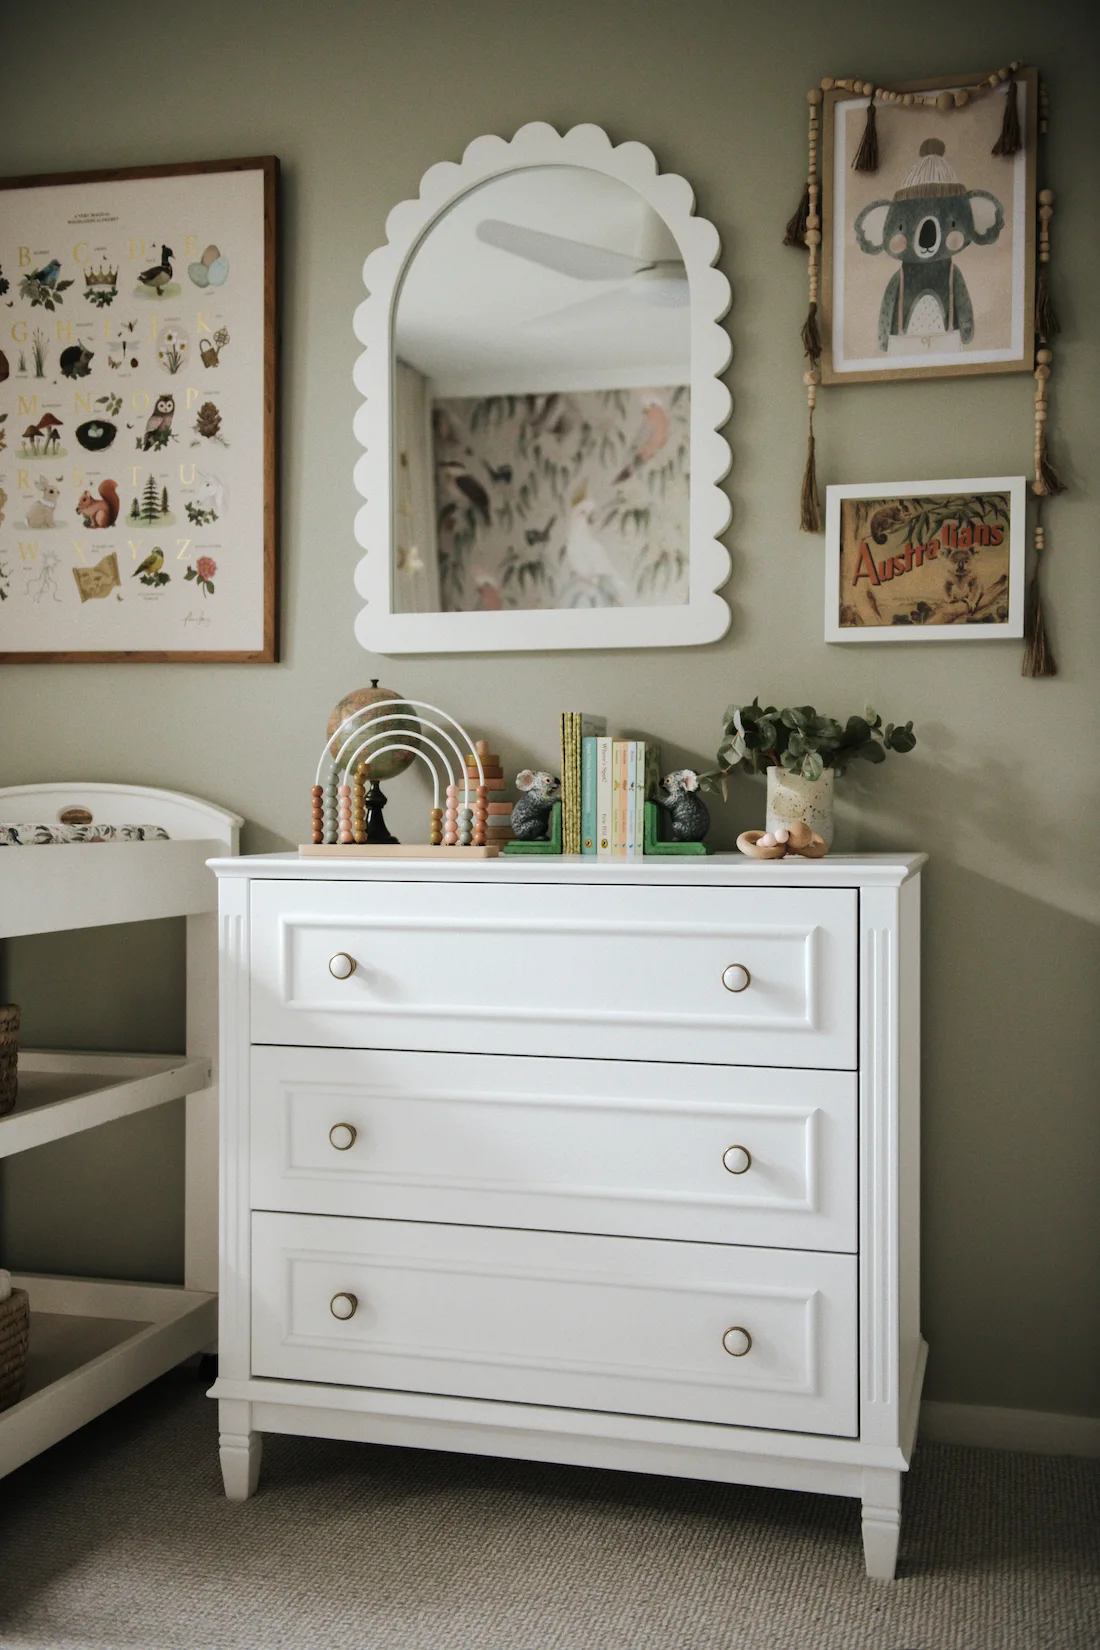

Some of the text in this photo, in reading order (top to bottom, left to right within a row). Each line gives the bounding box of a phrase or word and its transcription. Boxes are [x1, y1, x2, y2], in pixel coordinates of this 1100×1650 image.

[73, 241, 89, 263] C
[129, 238, 146, 260] D
[185, 234, 199, 257] E
[18, 246, 32, 268] B
[11, 321, 28, 342] G
[56, 319, 73, 341] H
[147, 313, 158, 342] J
[196, 312, 211, 333] K
[18, 395, 39, 417] M
[74, 392, 92, 414] N
[132, 391, 150, 413] O
[186, 387, 200, 409] P
[17, 468, 32, 490] R
[71, 467, 84, 489] S
[126, 466, 143, 487] T
[179, 464, 196, 485] U
[18, 541, 40, 561] W
[176, 539, 192, 560] Z
[852, 522, 1004, 587] Australians
